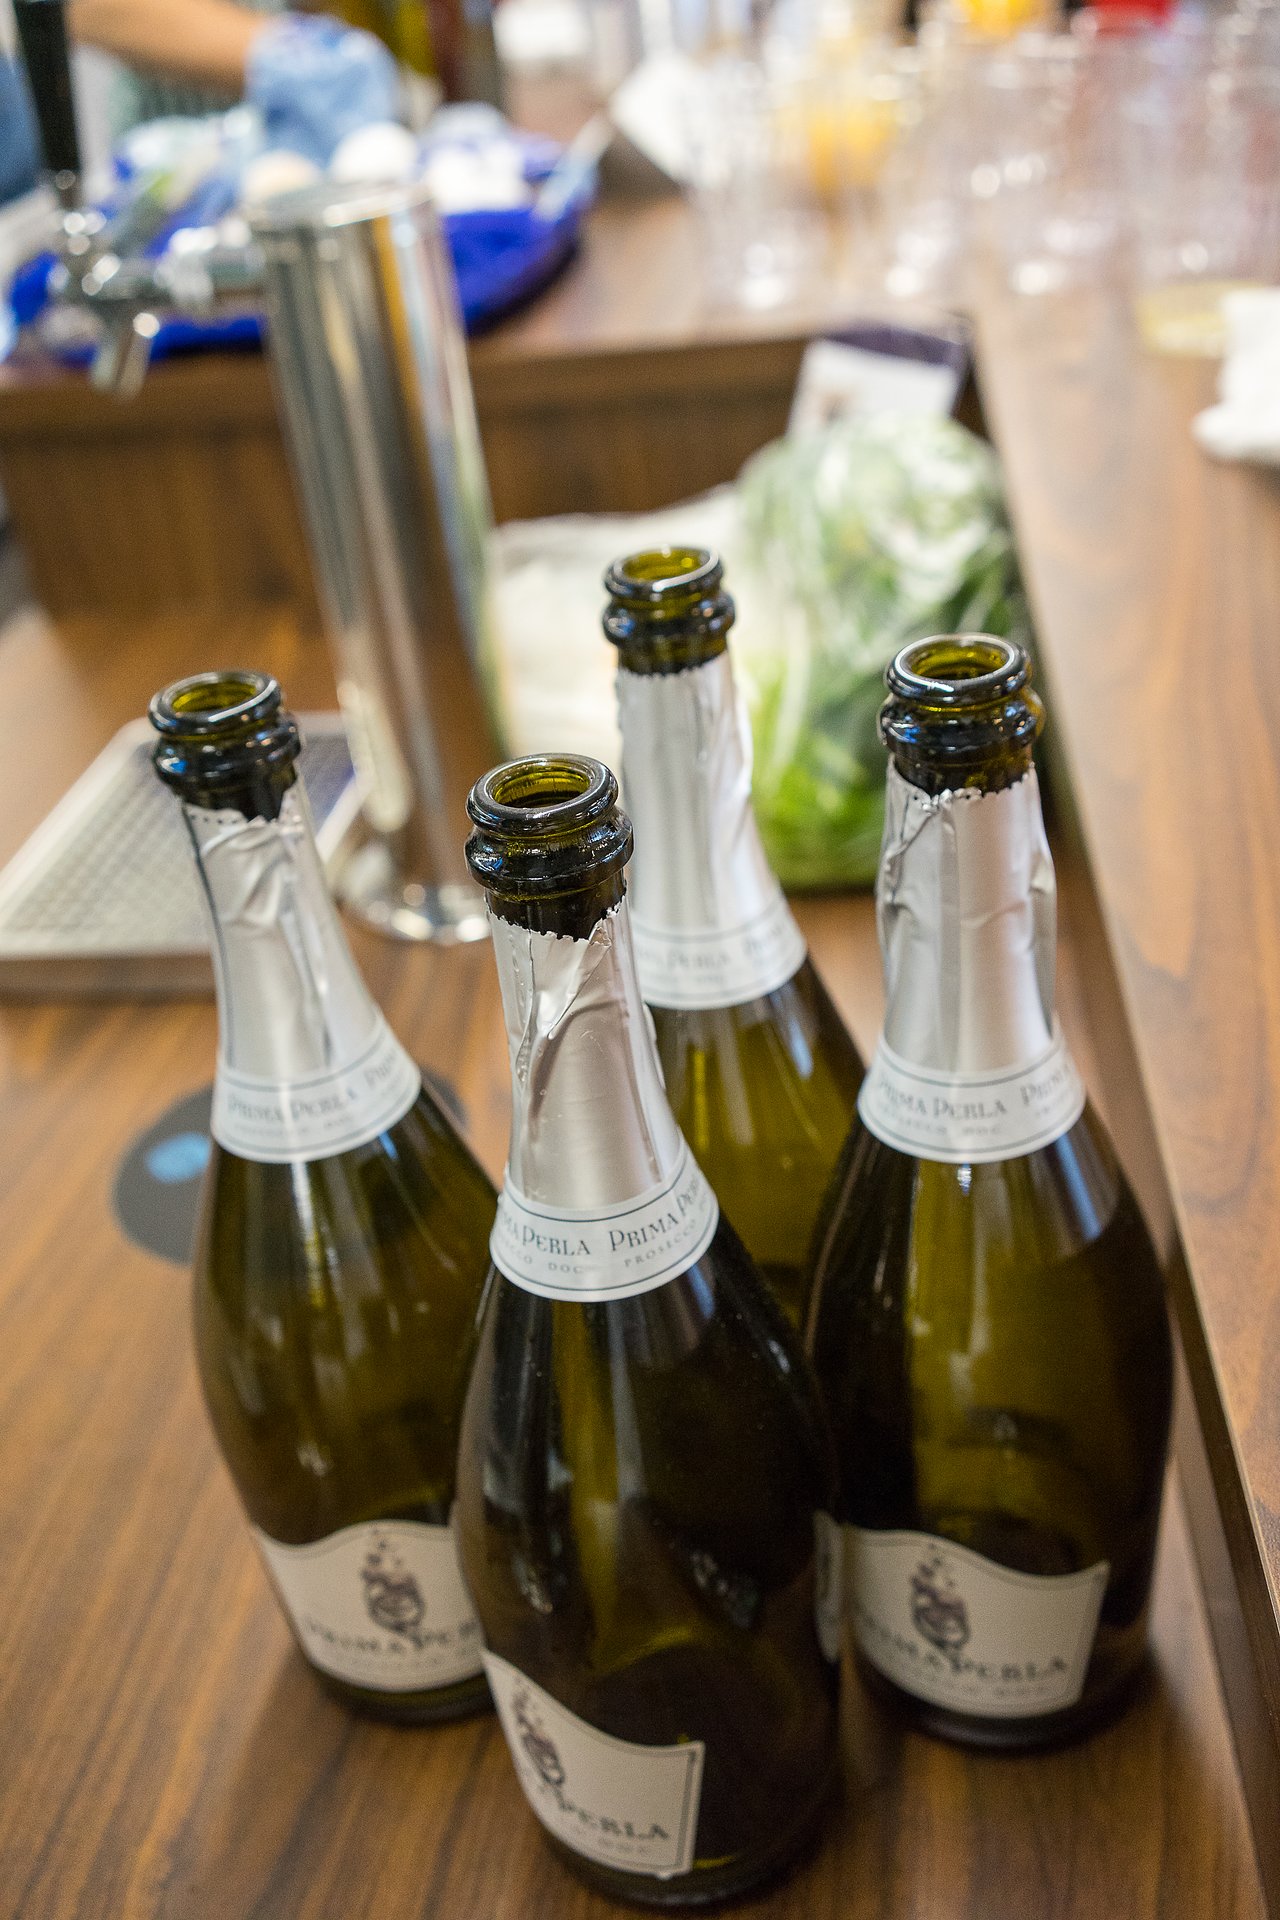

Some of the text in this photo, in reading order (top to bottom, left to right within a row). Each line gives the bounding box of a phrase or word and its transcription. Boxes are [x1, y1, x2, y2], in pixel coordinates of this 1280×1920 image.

[932, 1096, 1009, 1122] PERLA
[521, 1225, 592, 1257] PERLA
[607, 1212, 680, 1253] PRIMA
[623, 1217, 697, 1269] PROSECCO
